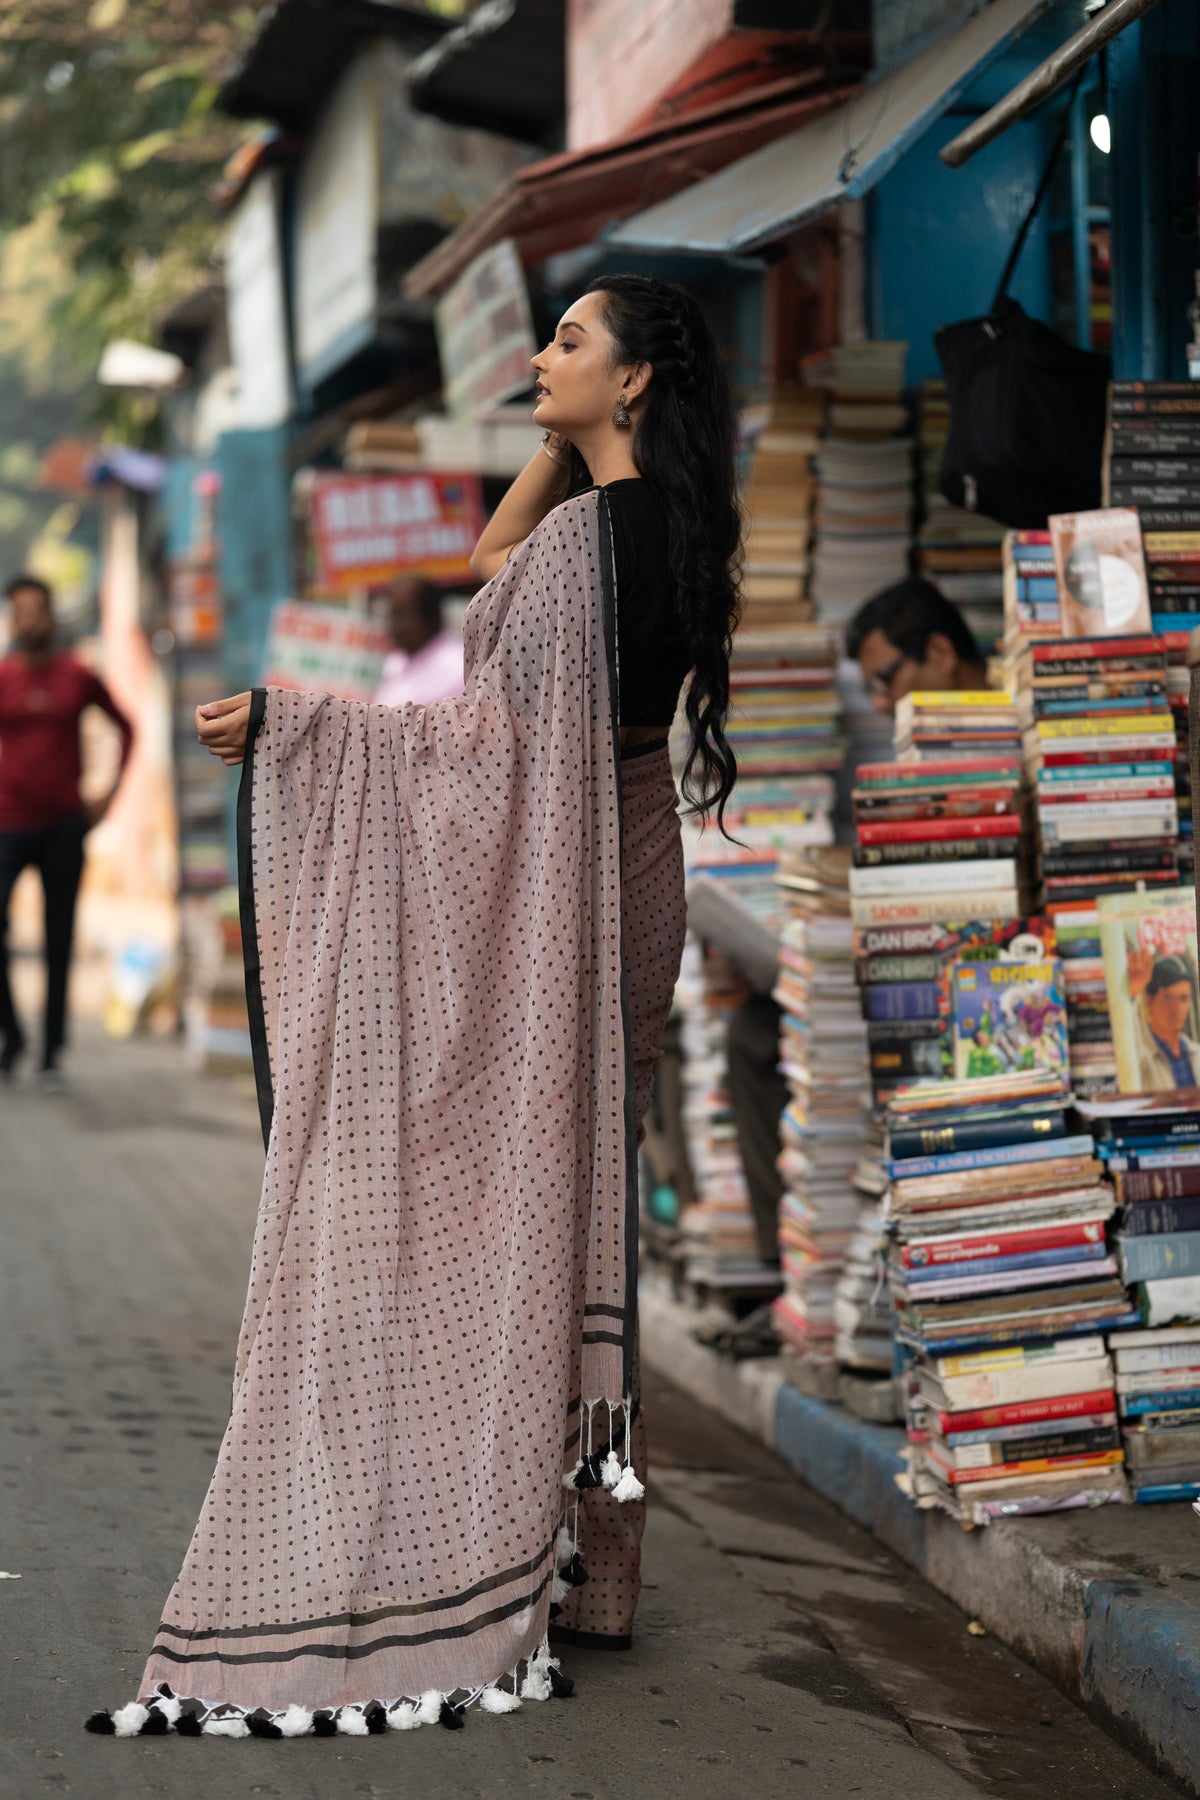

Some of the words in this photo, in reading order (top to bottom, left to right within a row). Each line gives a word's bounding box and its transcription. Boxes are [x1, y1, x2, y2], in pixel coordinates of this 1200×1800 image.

[869, 904, 920, 922] SACHIN
[867, 932, 900, 950] DAN
[870, 960, 900, 979] DAN
[1020, 1405, 1049, 1418] THIRD
[1051, 1400, 1084, 1414] SECRET
